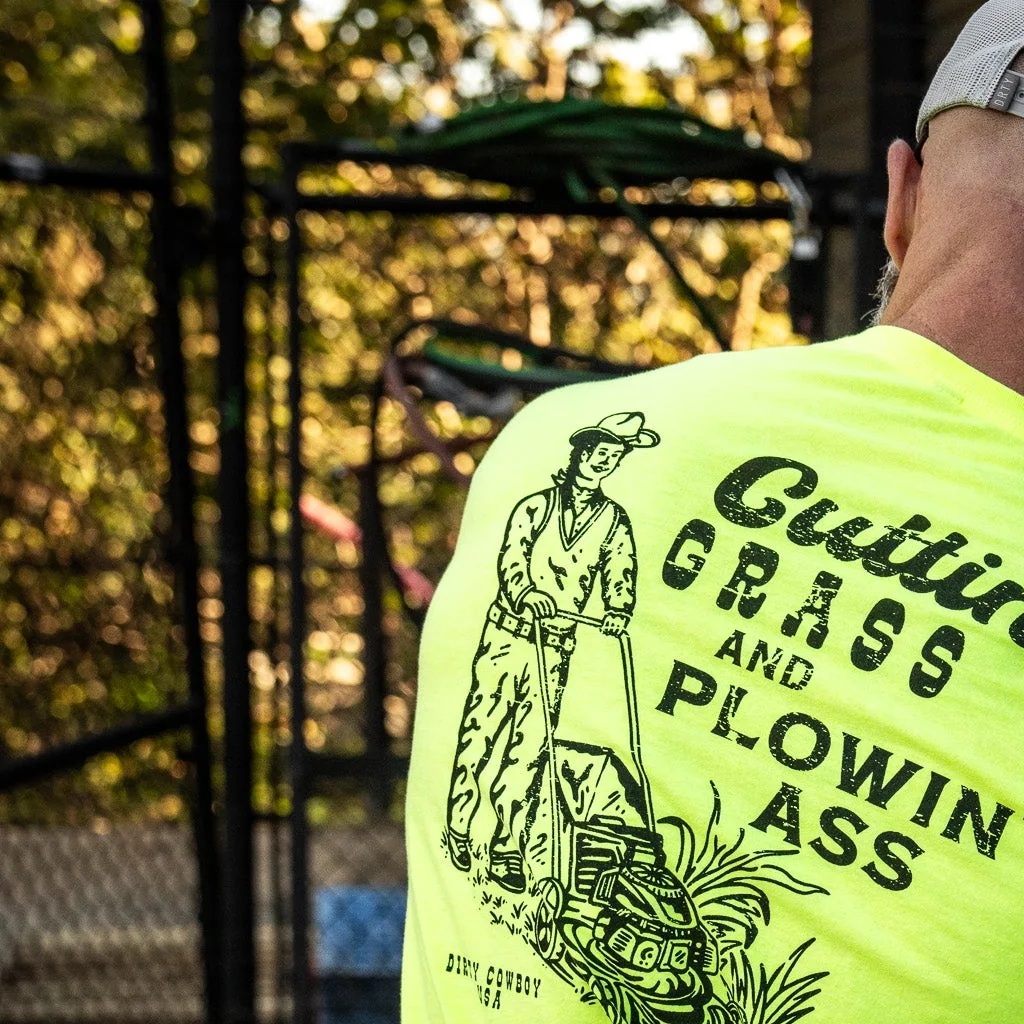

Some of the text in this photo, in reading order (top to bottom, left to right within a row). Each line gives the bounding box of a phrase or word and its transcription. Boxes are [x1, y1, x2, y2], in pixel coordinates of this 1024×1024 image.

[994, 77, 1014, 107] DRTY
[661, 518, 965, 699] GRASS
[713, 629, 815, 691] AND
[749, 781, 926, 892] ASS
[445, 953, 541, 998] DIRTY COWBOY
[476, 984, 502, 1010] USA
